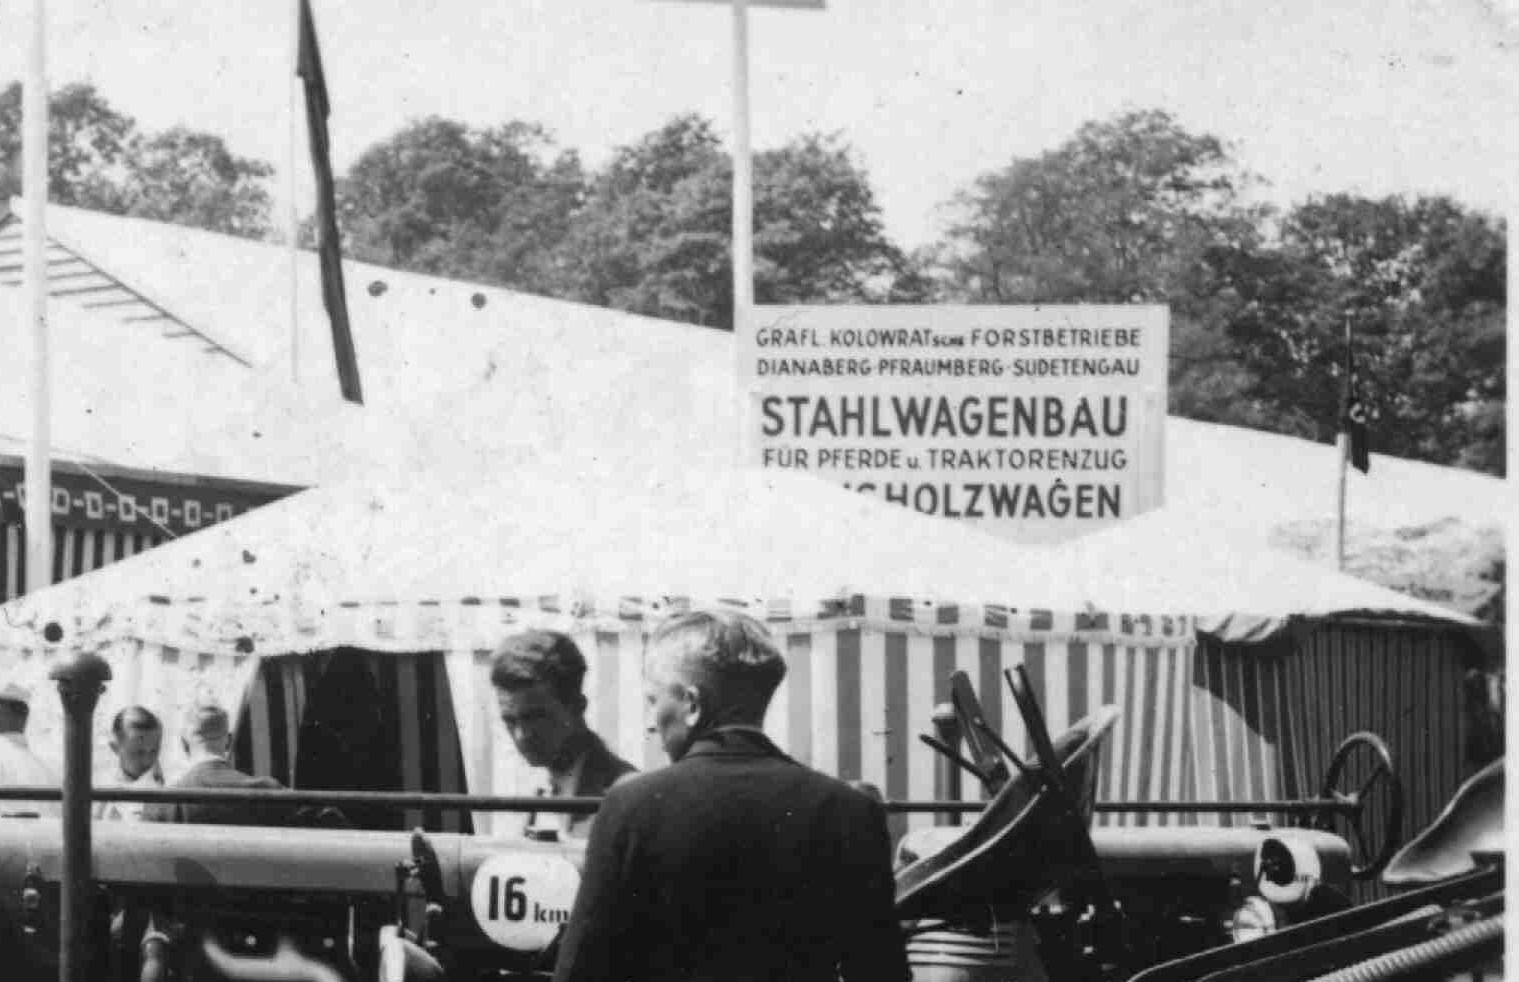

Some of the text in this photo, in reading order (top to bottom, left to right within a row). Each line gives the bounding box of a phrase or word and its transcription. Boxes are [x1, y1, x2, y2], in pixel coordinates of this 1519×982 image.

[971, 327, 1142, 348] FORSTBETRIEBE
[761, 394, 1128, 438] STAHLWAGENBAU
[762, 446, 809, 471] FÜR
[817, 448, 902, 471] PFERDE
[927, 447, 1129, 471] TRAKTORENZUG
[487, 874, 570, 923] 16 km
